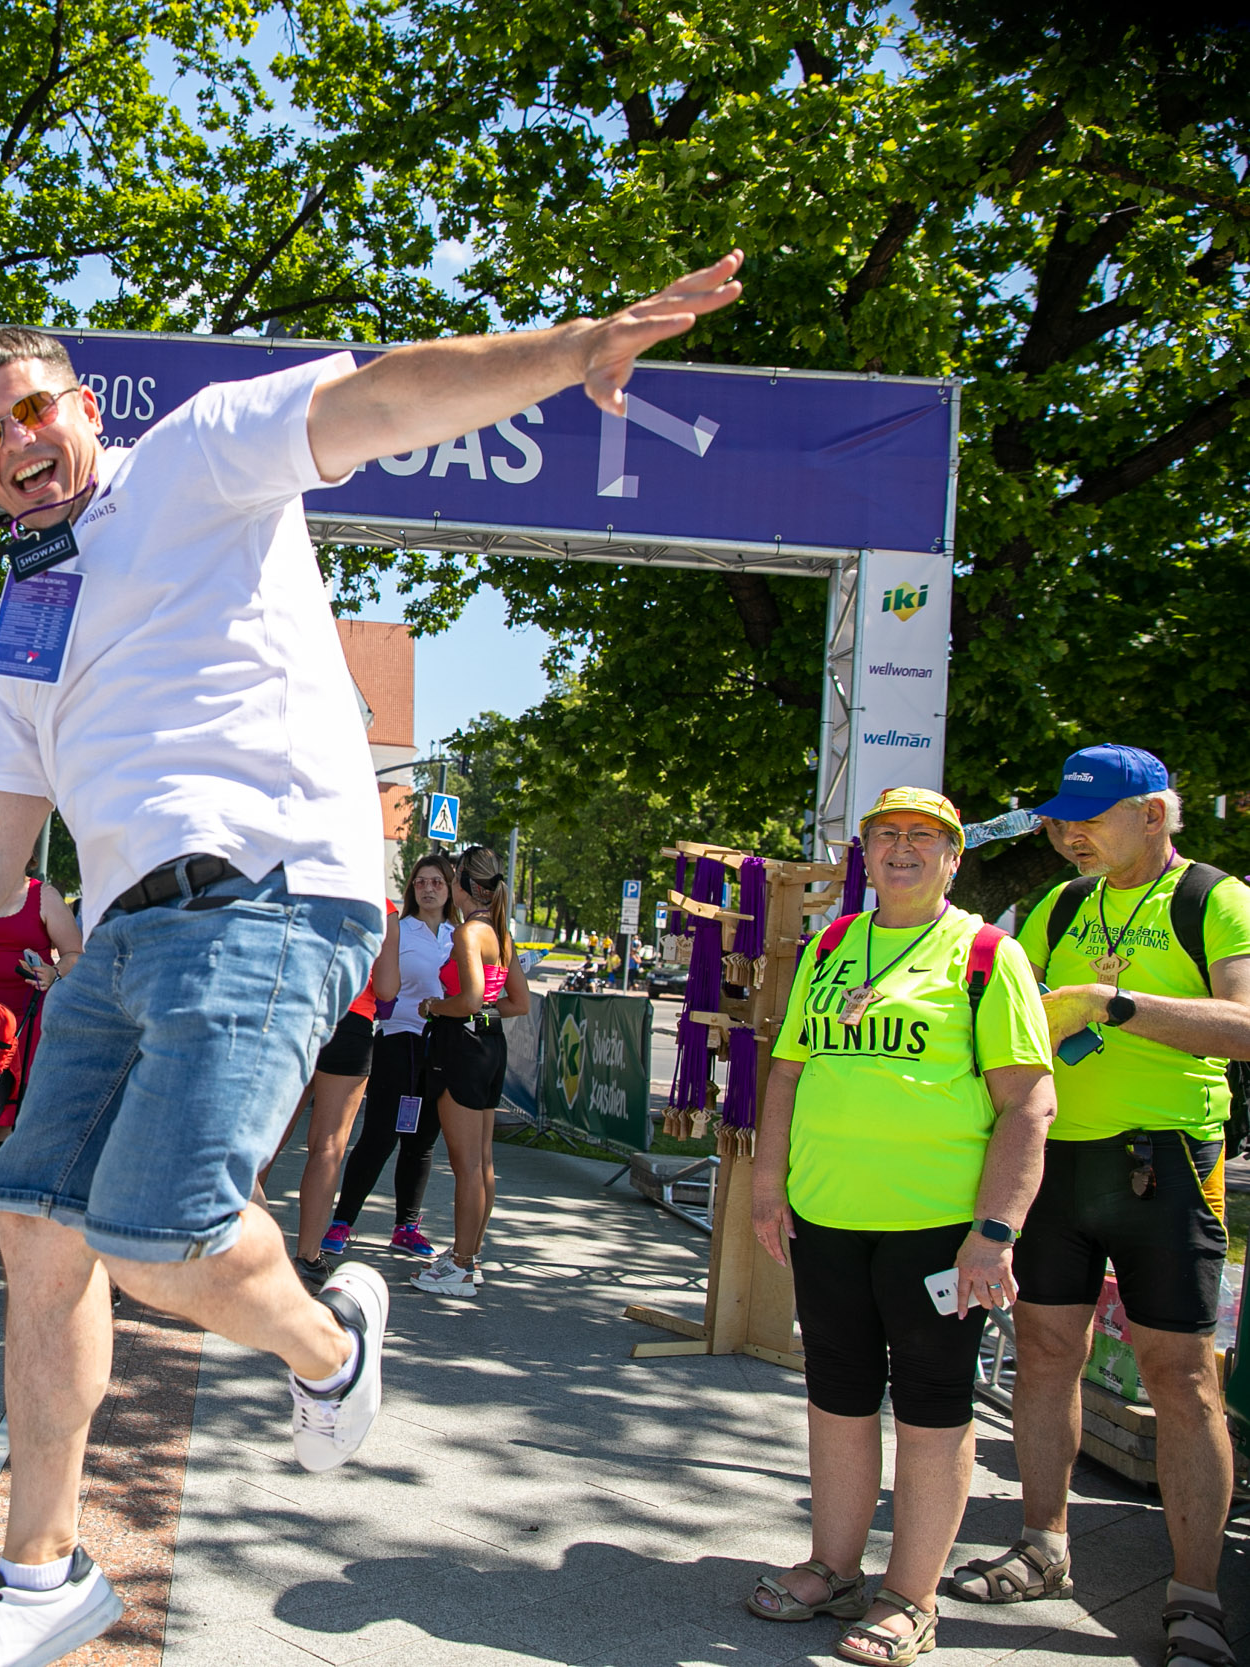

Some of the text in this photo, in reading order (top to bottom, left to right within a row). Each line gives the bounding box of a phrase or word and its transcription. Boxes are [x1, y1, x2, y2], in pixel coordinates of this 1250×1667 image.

[20, 540, 66, 567] SHOWART
[881, 584, 929, 612] iki
[869, 663, 933, 678] wellwoman
[627, 883, 638, 897] P
[804, 1016, 930, 1054] ILNIUS
